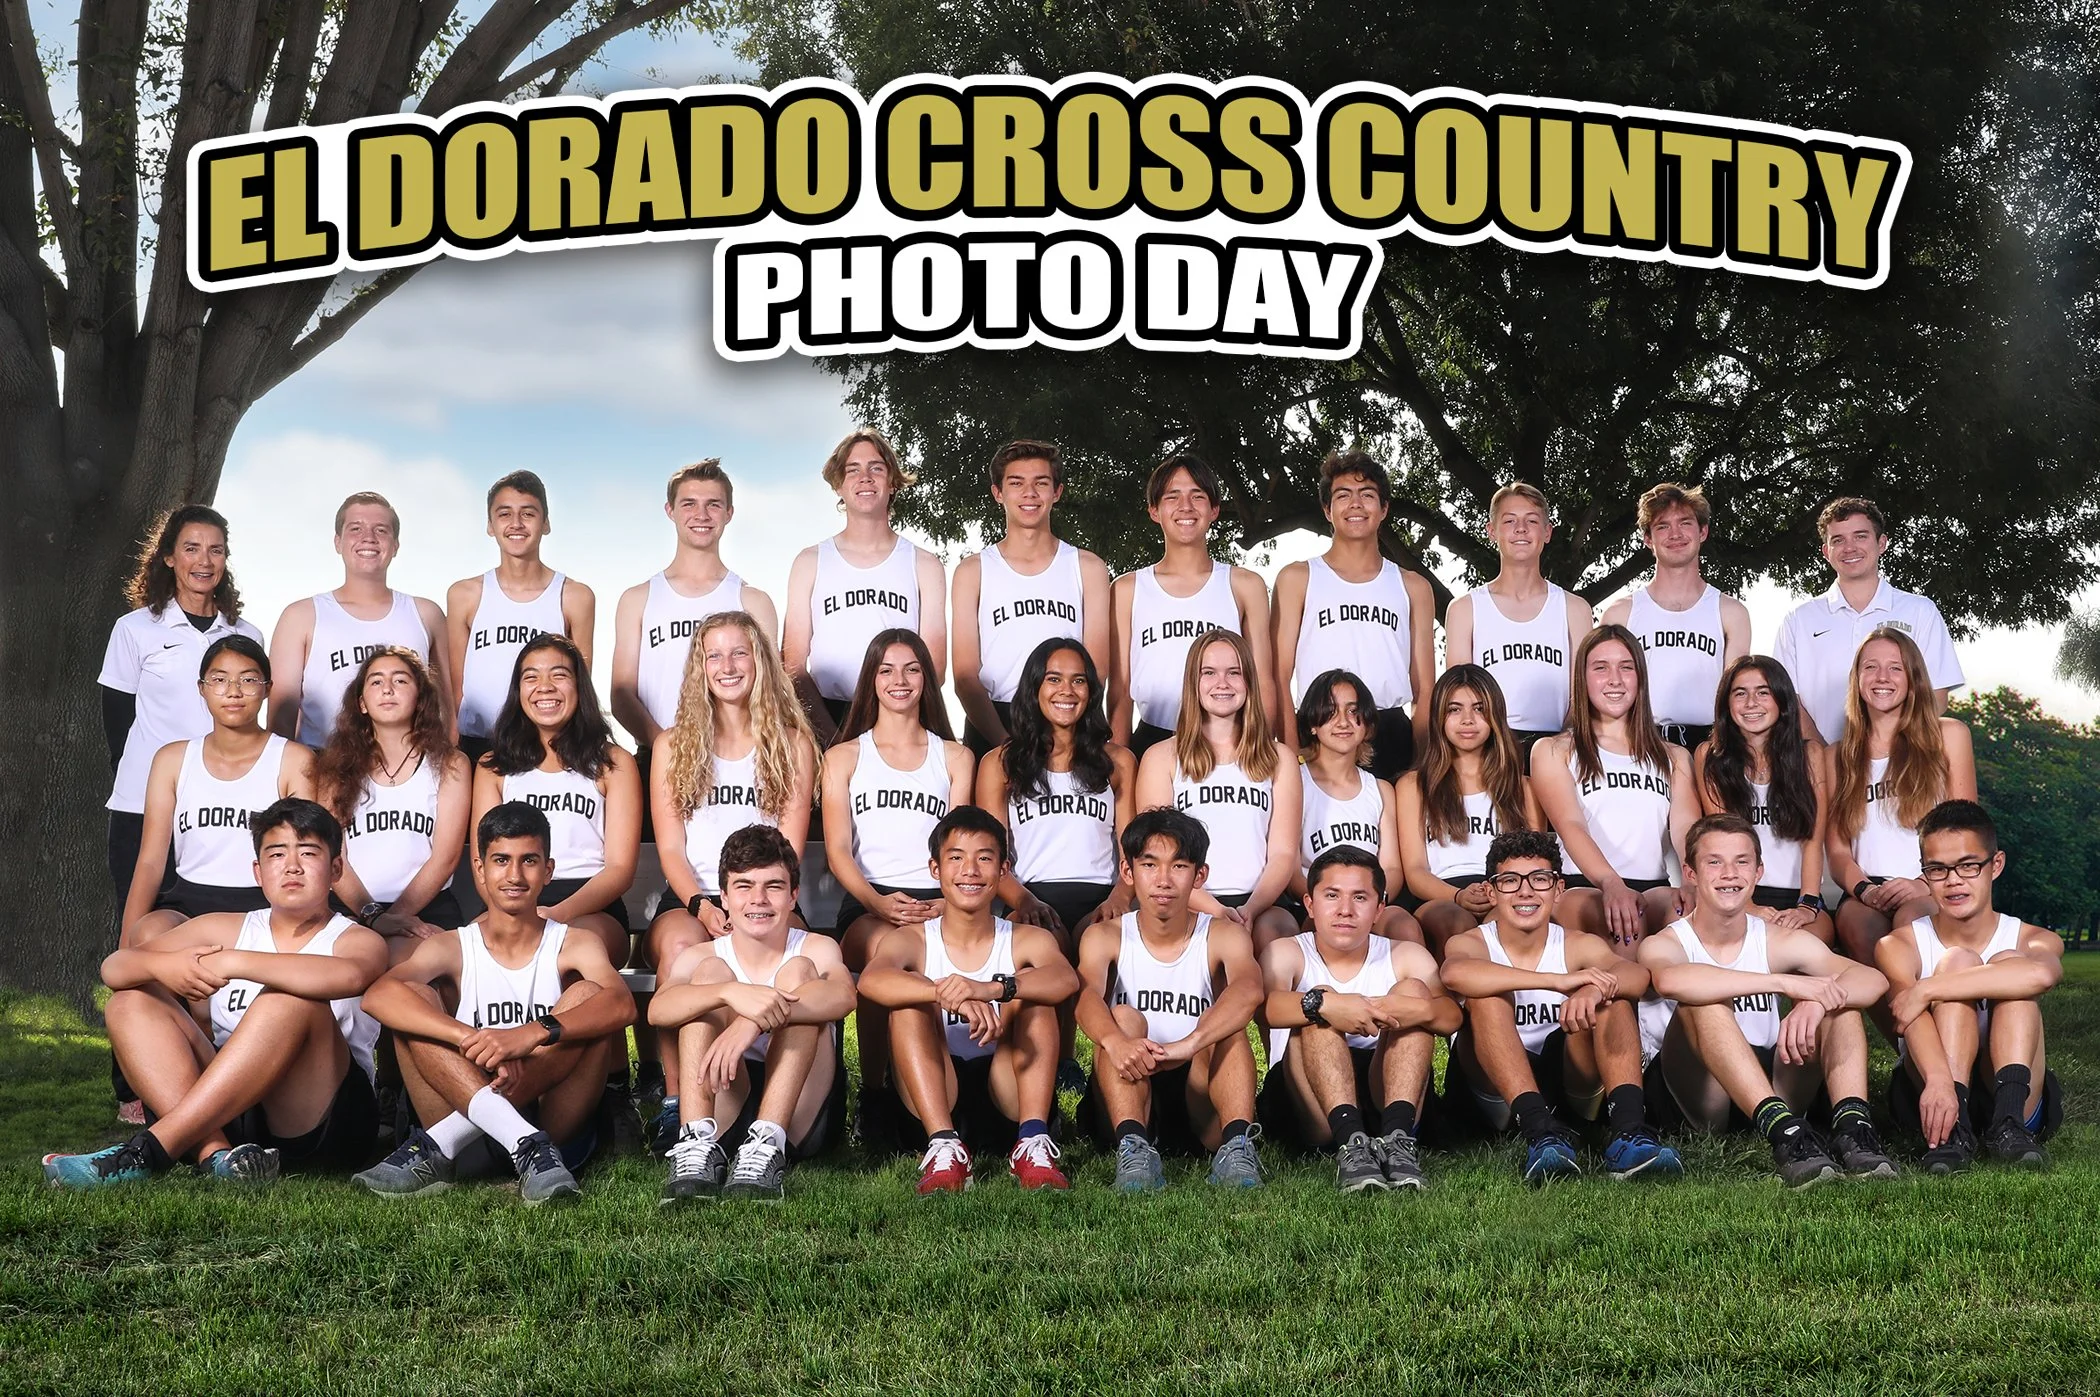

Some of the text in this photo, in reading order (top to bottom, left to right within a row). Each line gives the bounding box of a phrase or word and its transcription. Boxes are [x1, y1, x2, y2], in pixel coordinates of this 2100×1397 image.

[824, 589, 908, 616] EL DORADO
[993, 599, 1076, 626] EL DORADO
[1319, 605, 1398, 631] EL DORADO
[475, 629, 490, 650] EL
[649, 626, 665, 648] EL
[1142, 627, 1157, 647] EL
[1655, 631, 1716, 657] DORADO
[331, 648, 348, 671] EL
[1483, 644, 1562, 668] EL DORADO
[1582, 773, 1601, 796] EL
[855, 790, 946, 821] EL DORADO
[1017, 795, 1107, 825] EL DORADO
[1177, 786, 1268, 812] EL DORADO
[179, 807, 248, 834] EL DORA
[366, 810, 434, 837] DORADO
[1310, 822, 1378, 854] EL DORAD
[228, 989, 247, 1012] EL
[1515, 1003, 1559, 1026] ORAD
